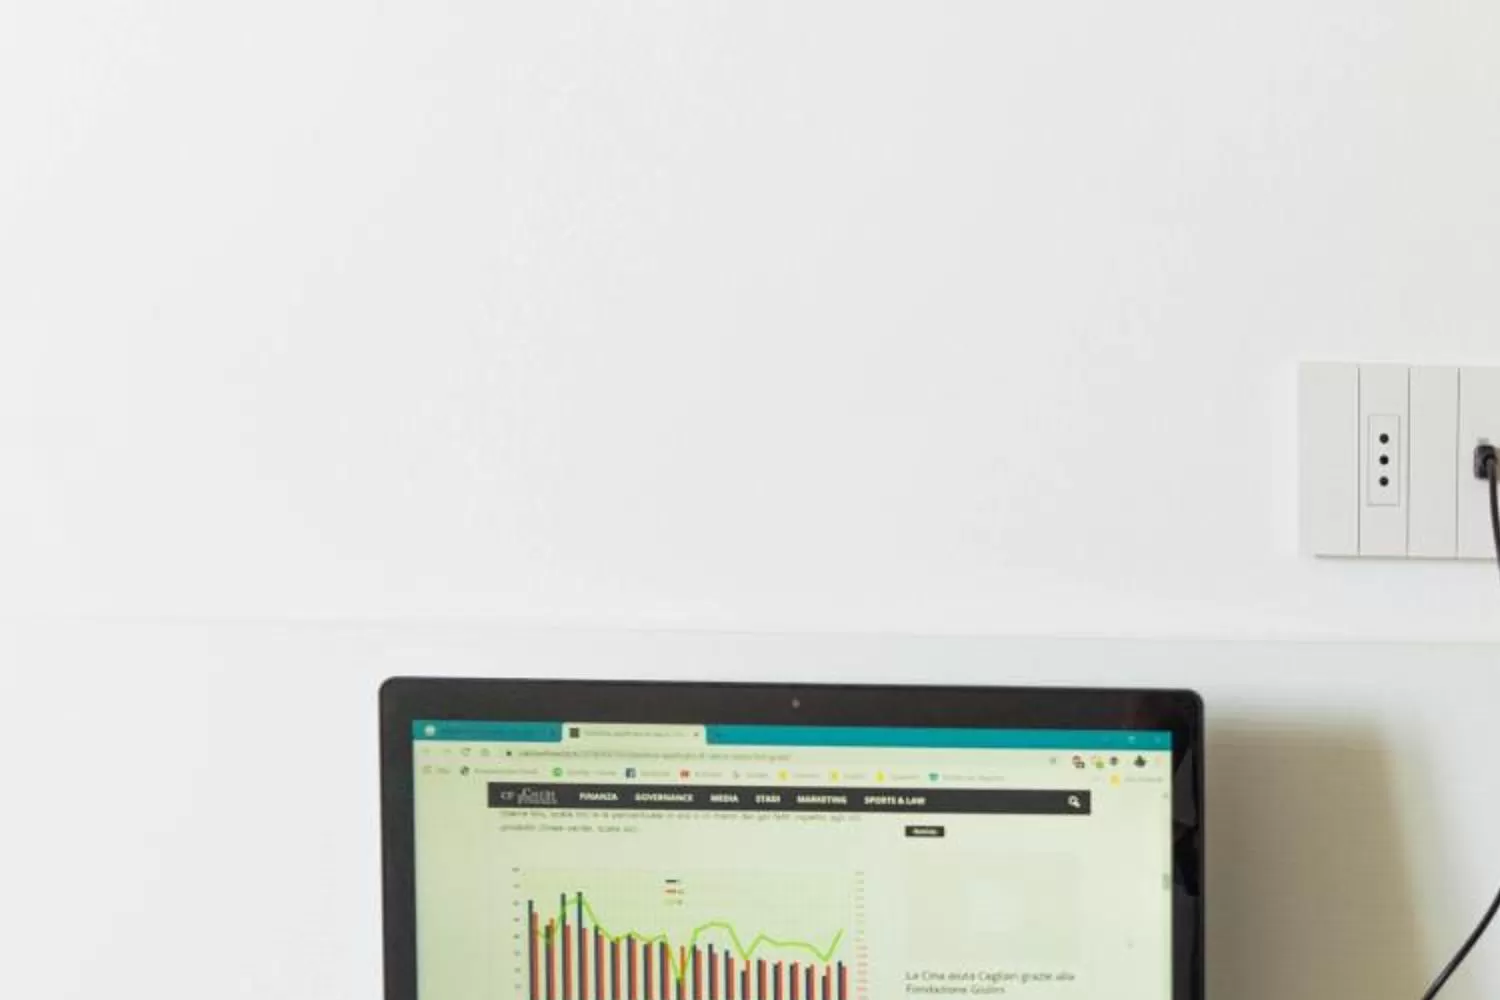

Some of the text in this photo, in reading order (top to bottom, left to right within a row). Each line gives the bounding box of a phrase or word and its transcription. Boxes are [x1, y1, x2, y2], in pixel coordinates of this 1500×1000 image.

[579, 791, 619, 801] FINANZA
[635, 792, 694, 802] GOVERNANCE
[709, 793, 740, 803] MEDIA
[797, 795, 847, 805] MARKETING
[864, 796, 896, 805] SPORTS
